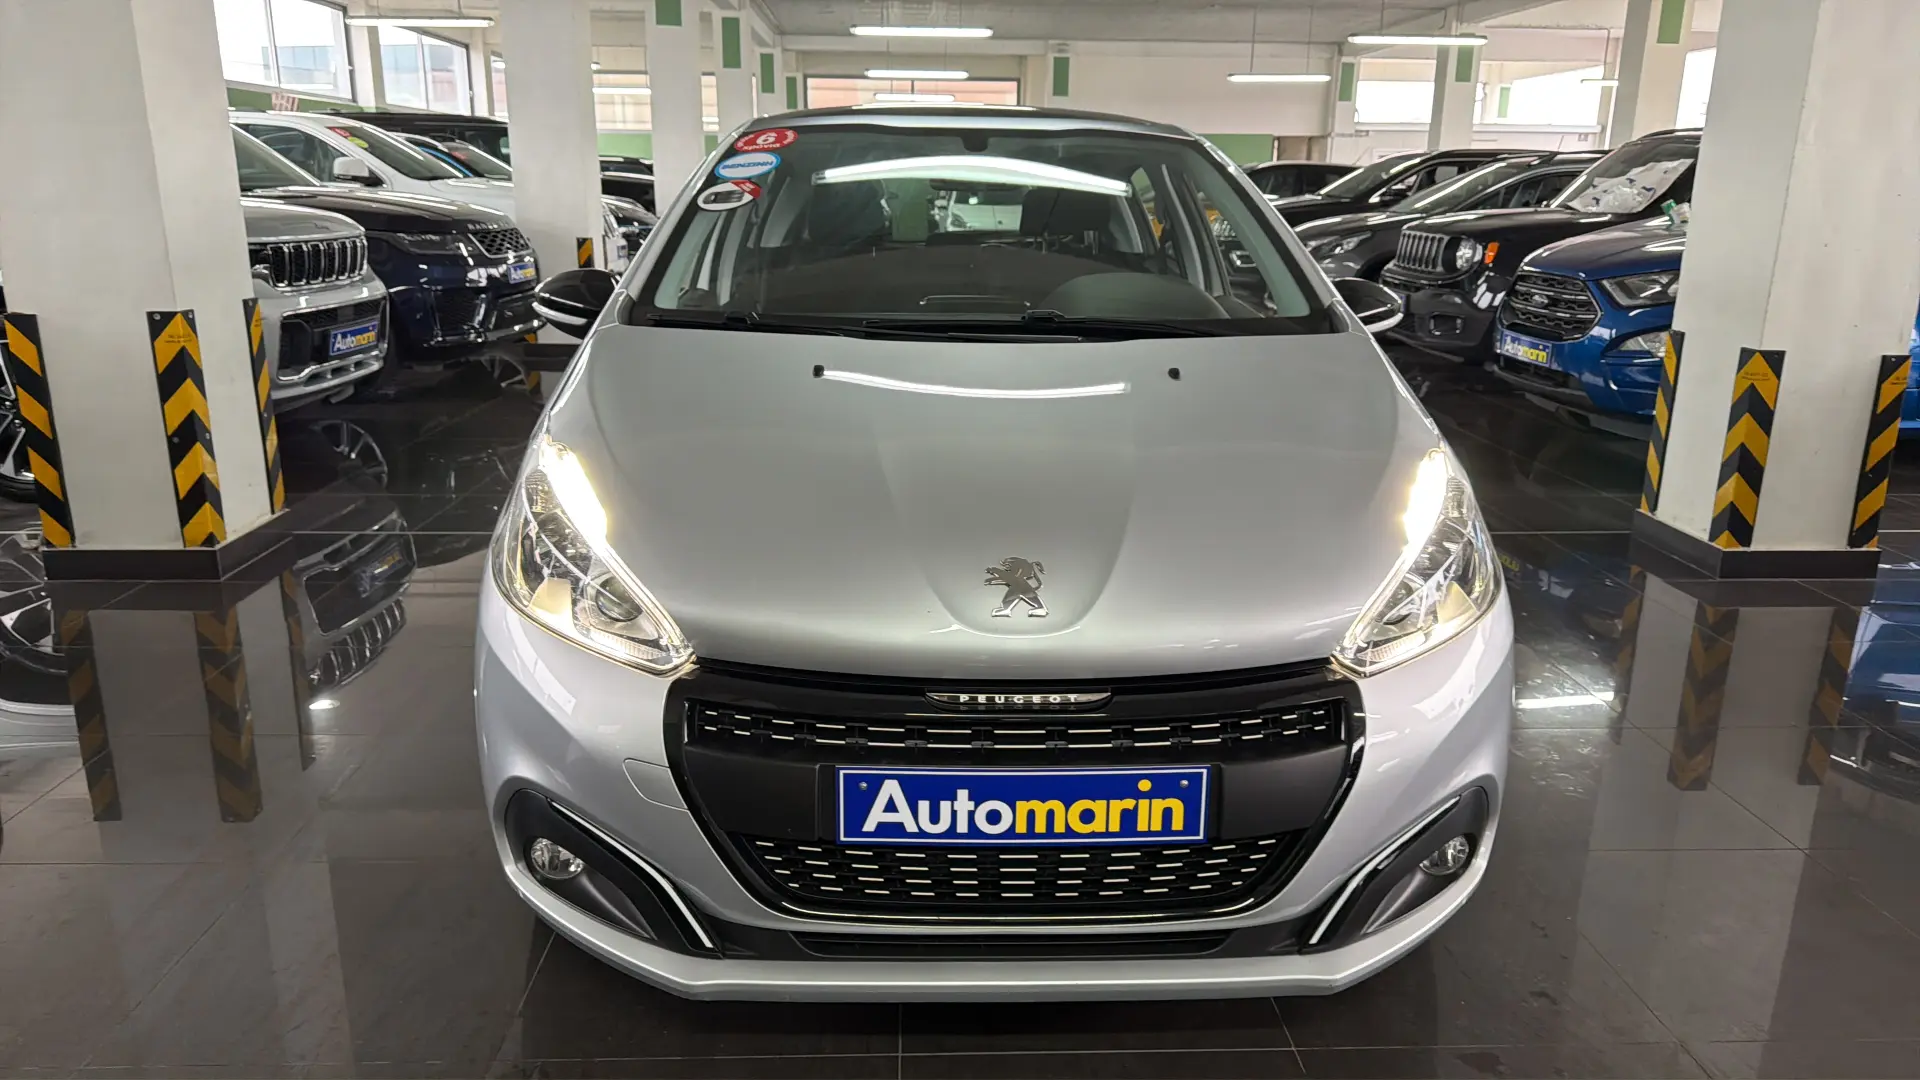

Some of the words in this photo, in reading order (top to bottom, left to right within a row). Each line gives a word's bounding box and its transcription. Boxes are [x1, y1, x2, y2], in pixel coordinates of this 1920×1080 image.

[756, 132, 777, 145] 6
[959, 694, 1078, 703] PEUGEOT
[861, 779, 1185, 834] Automarin
